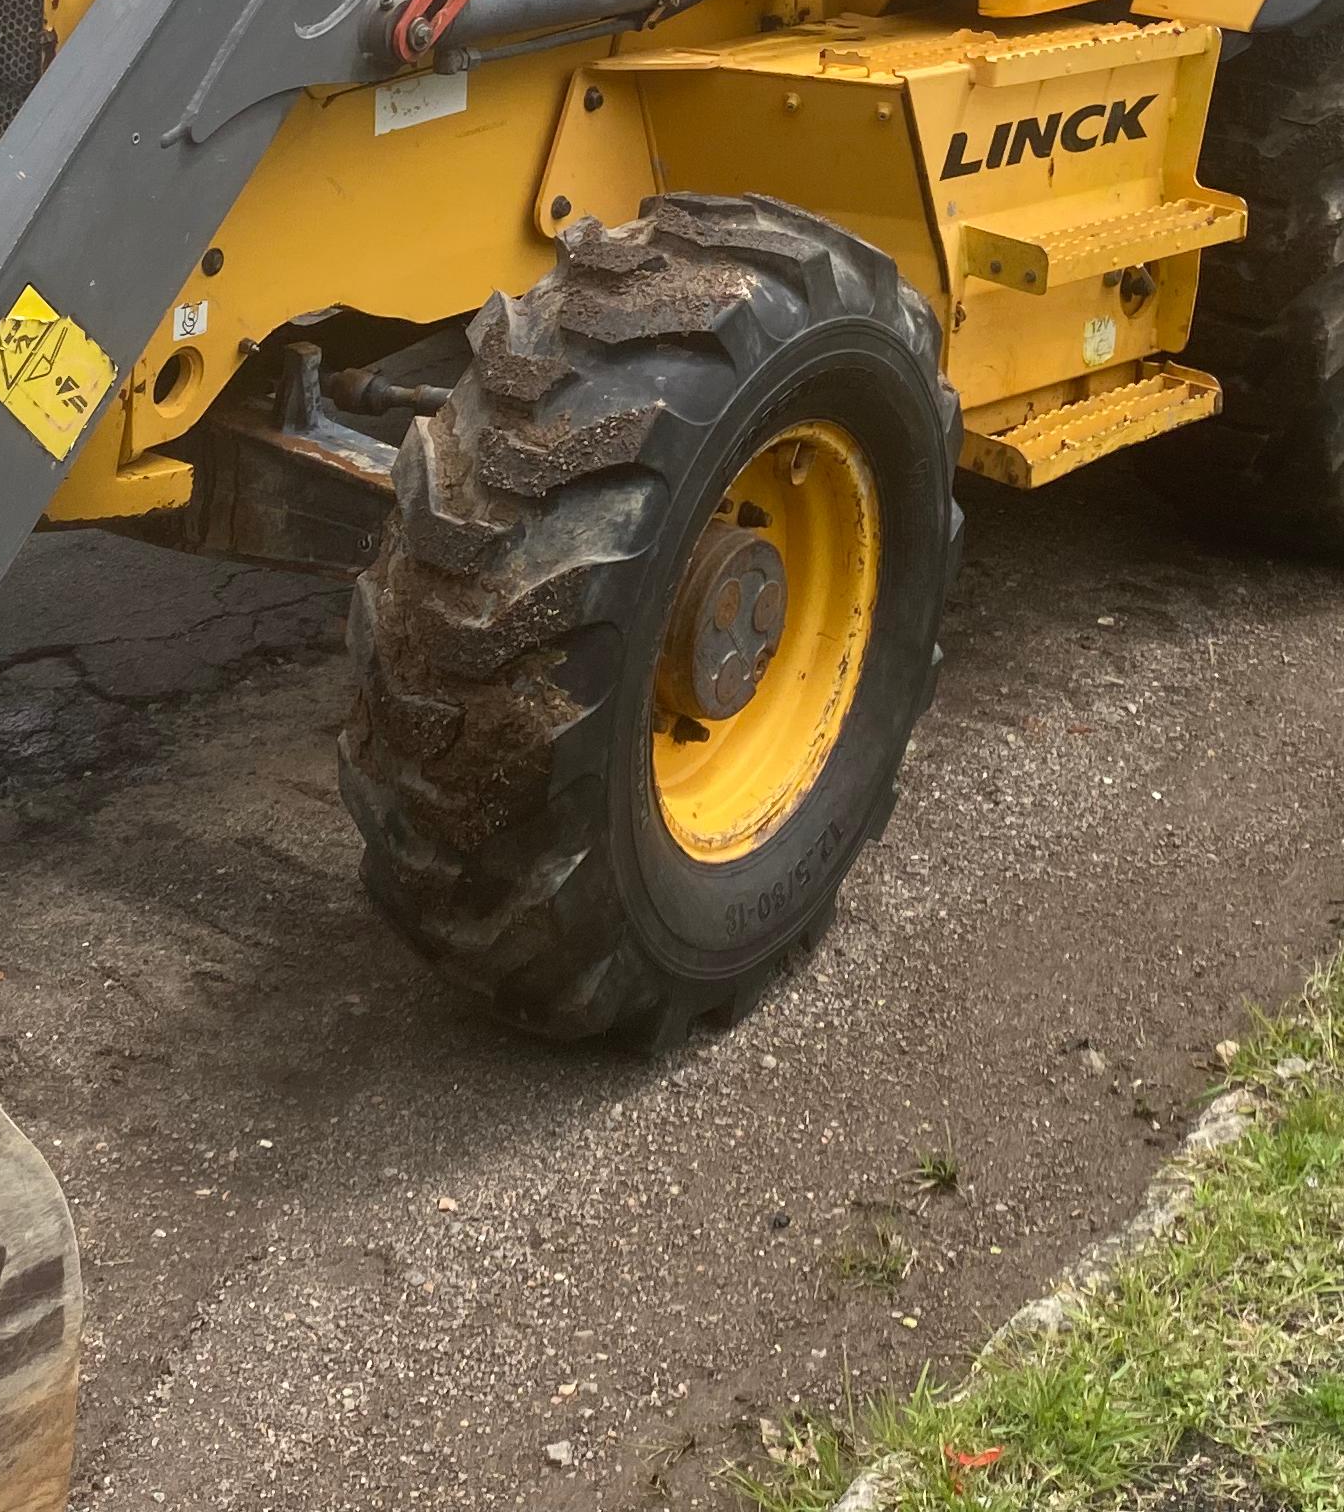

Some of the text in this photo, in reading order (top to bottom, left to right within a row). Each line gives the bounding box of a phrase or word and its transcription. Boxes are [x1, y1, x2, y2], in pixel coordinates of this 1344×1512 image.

[940, 94, 1159, 181] LINCK
[1091, 316, 1111, 334] 12V
[725, 820, 845, 937] 12.5/80-18
